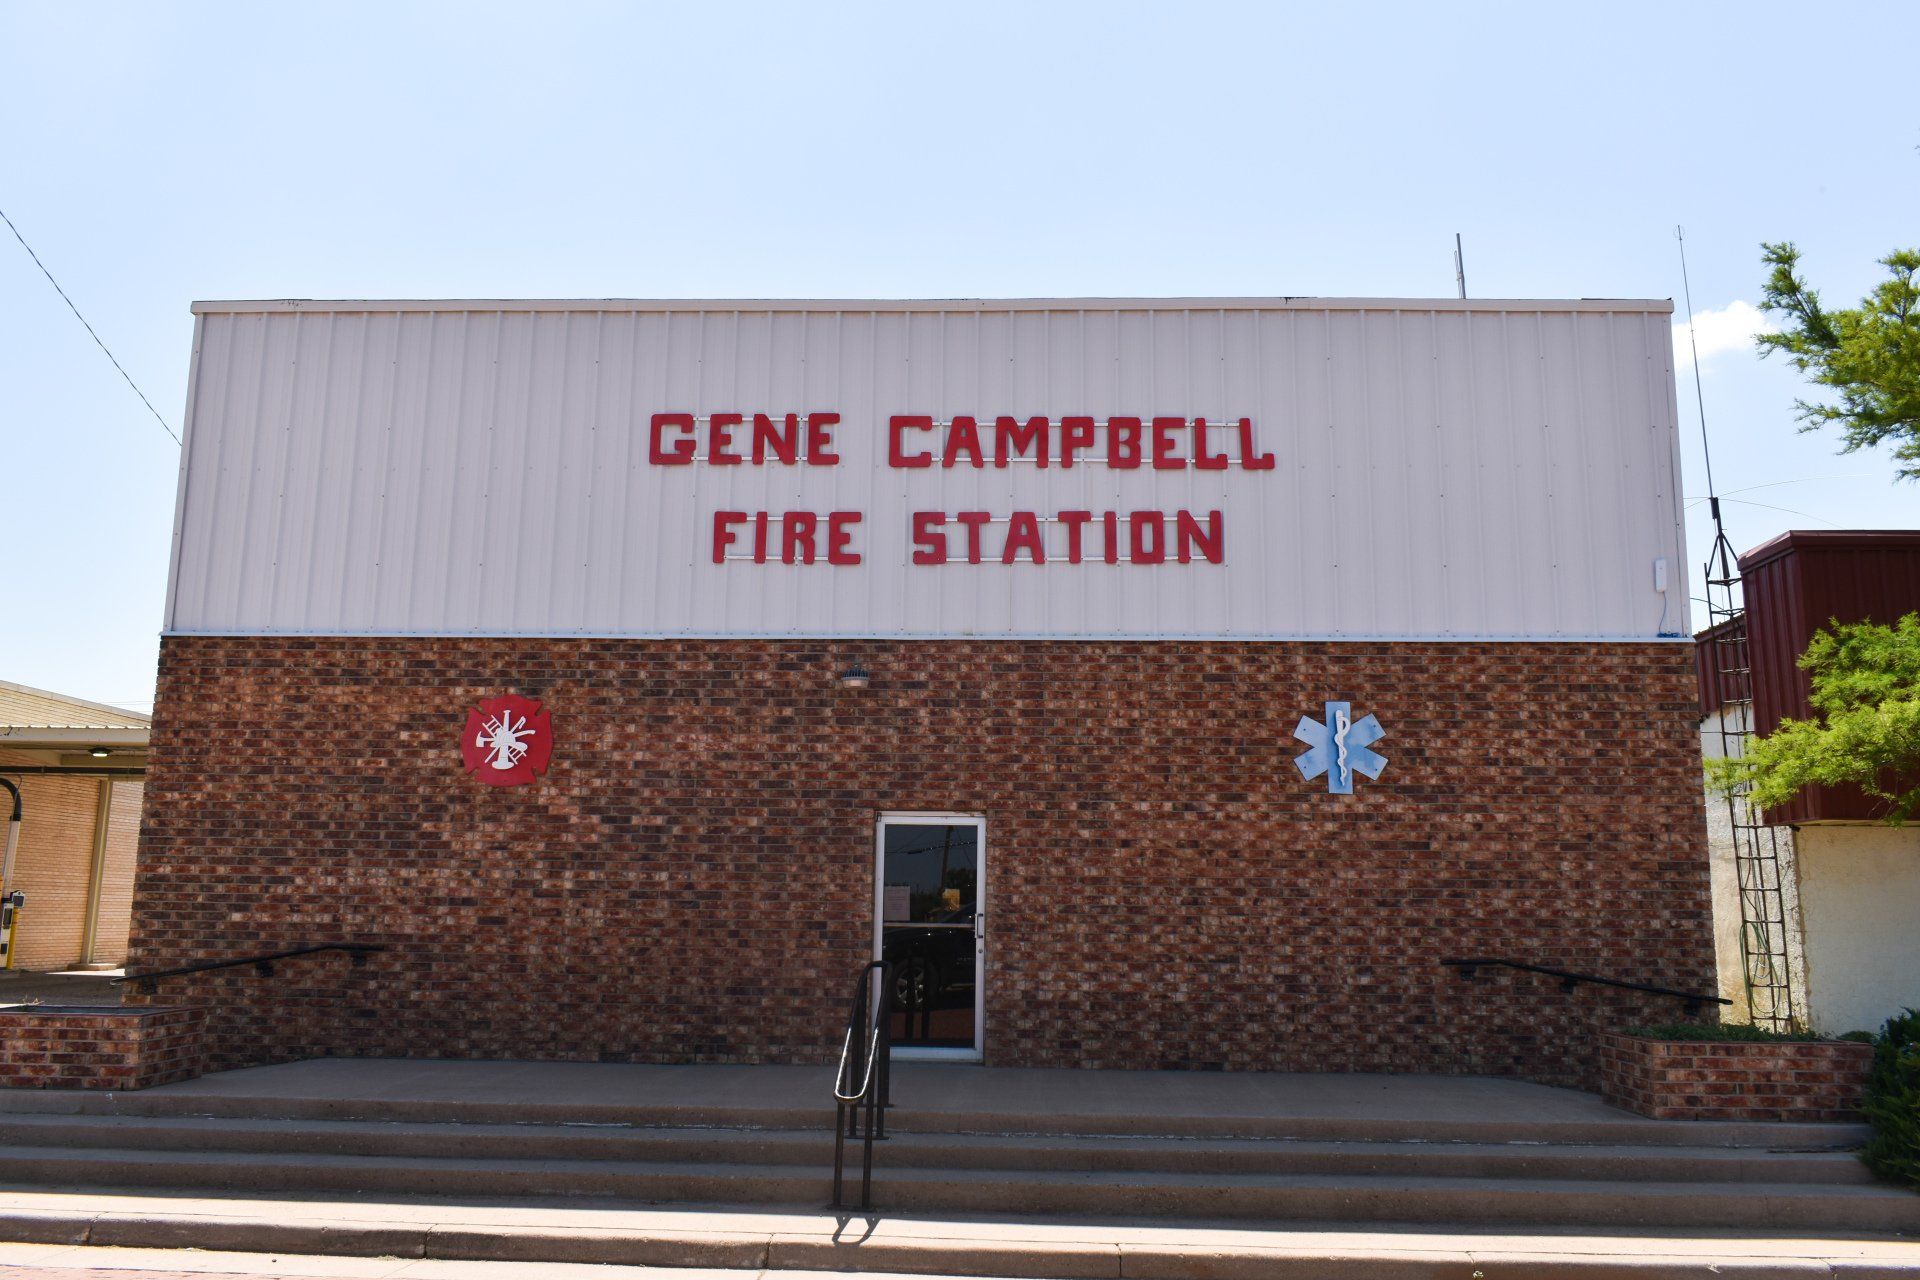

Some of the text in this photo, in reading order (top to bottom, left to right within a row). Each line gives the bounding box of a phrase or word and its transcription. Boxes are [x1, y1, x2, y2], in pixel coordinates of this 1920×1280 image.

[649, 413, 1276, 471] GENE CAMPBELL
[713, 510, 1223, 566] FIRE STATION
